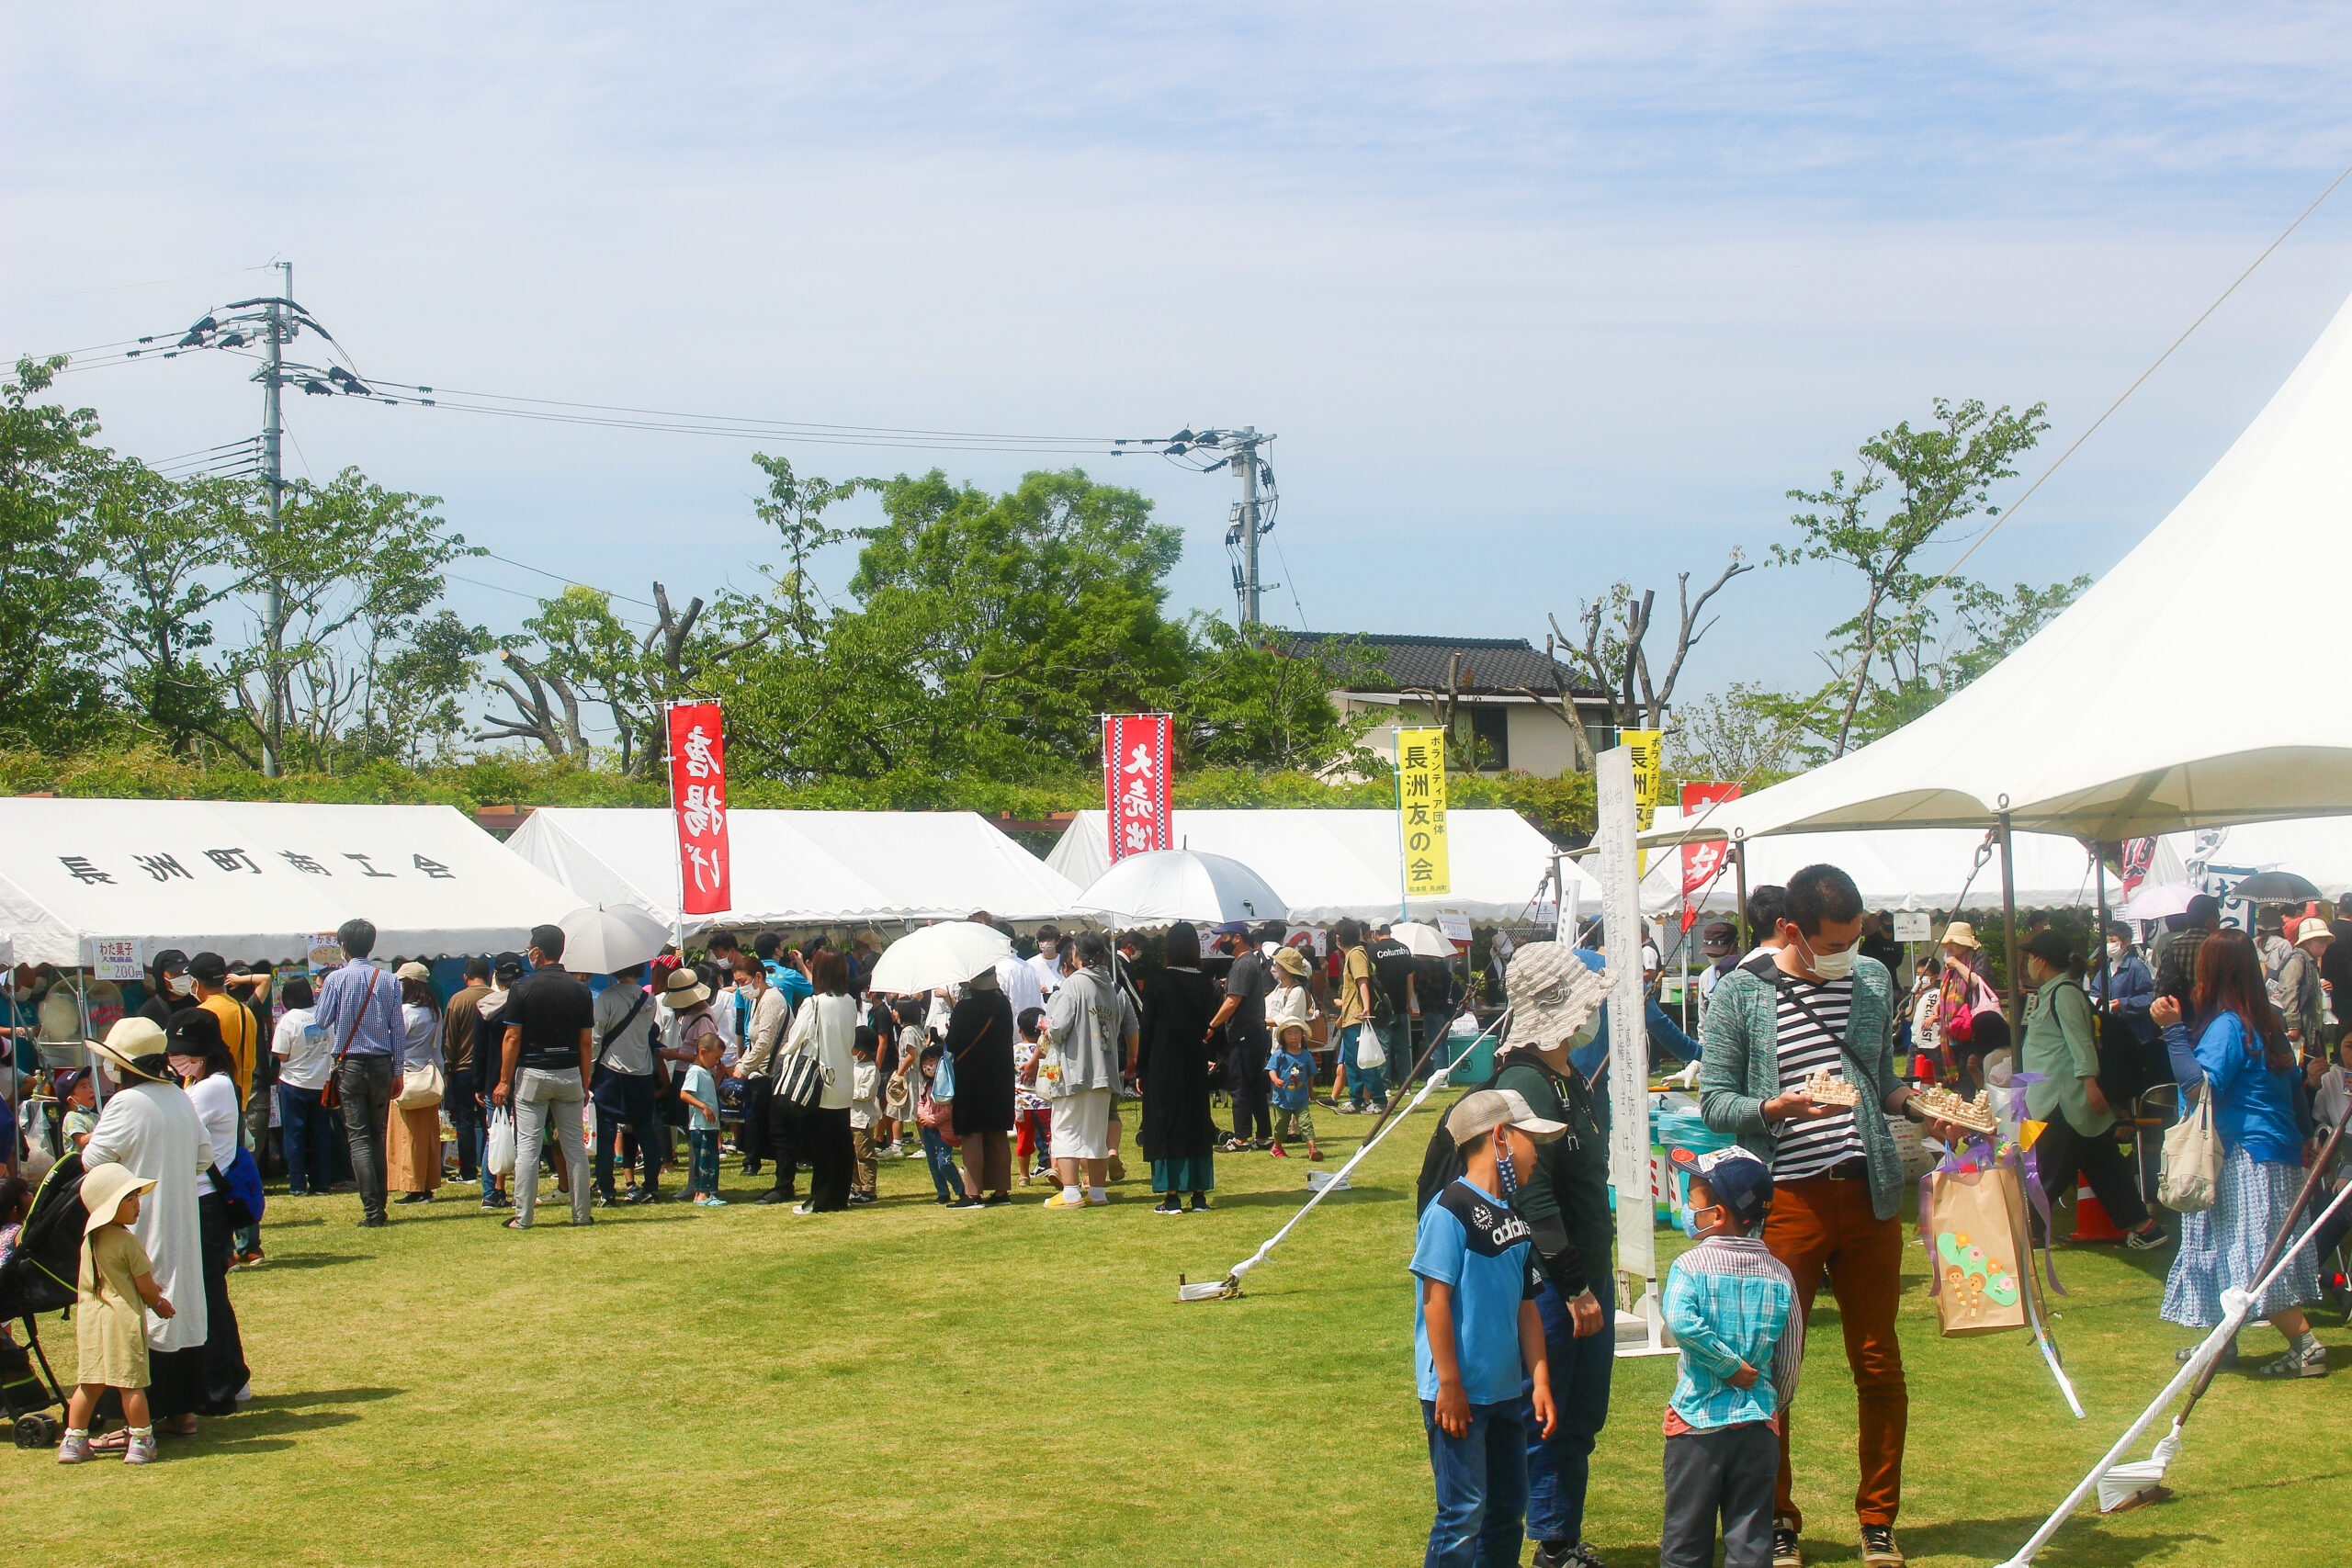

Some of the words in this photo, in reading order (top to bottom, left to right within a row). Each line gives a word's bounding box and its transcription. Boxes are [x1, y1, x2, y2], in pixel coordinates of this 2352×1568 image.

[1430, 736, 1445, 835] ボランティア団体
[1405, 746, 1433, 882] 長洲友の会
[57, 847, 458, 886] 長洲町商工会
[99, 942, 133, 956] わた菓子
[114, 964, 143, 978] 200円
[1921, 993, 1938, 1043] SPECIIST
